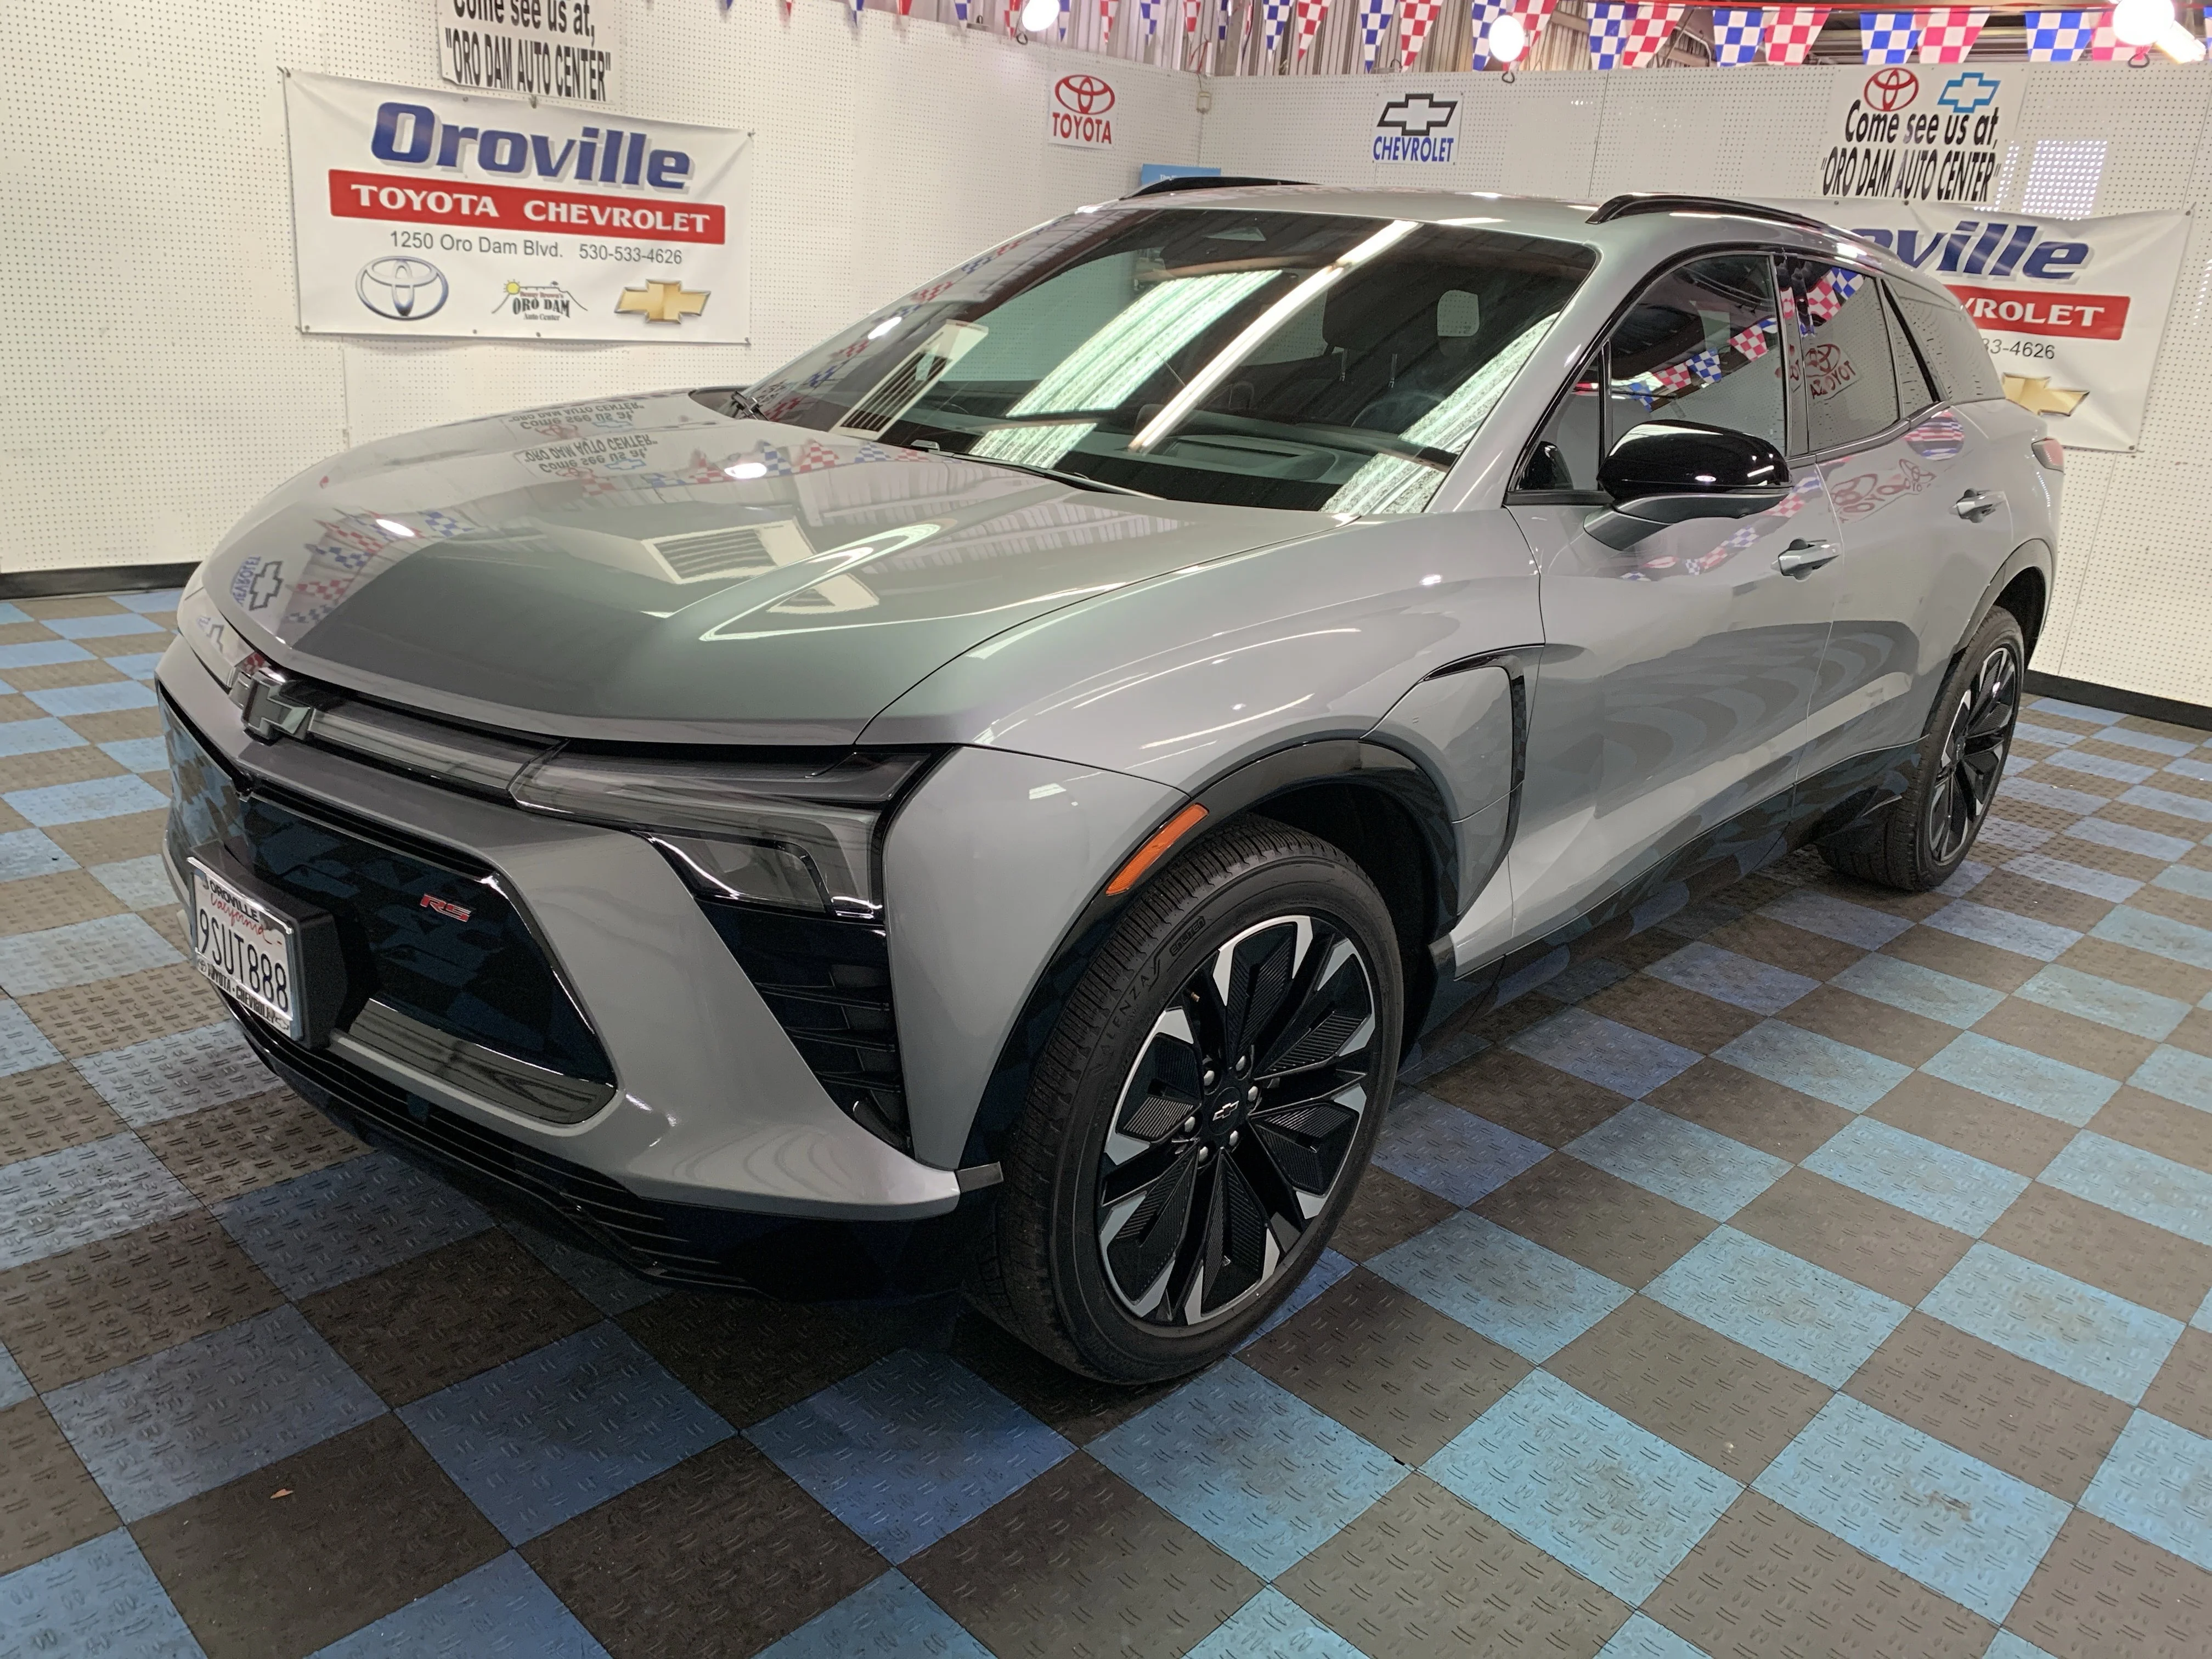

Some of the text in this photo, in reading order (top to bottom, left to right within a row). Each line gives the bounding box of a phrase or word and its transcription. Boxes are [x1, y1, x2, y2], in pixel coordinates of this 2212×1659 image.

[510, 0, 541, 29] see
[549, 0, 567, 33] us
[574, 0, 595, 48] at,
[445, 27, 612, 101] "ORO DAM AUTO CENTER"
[371, 101, 692, 192] Oroville
[1052, 111, 1111, 144] TOYOTA
[1846, 99, 1999, 150] Come see us at,
[1373, 136, 1454, 162] CHEVROLET
[1820, 146, 2001, 202] "ORO DAM AUTO CENTER"
[351, 184, 710, 233] TOYOTA CHEVROLET
[390, 231, 683, 265] 1250 Oro Dam Blvd. 530-533-4626
[512, 297, 570, 318] ORO DAM
[210, 880, 259, 923] OROVILLE
[420, 894, 472, 922] RS
[200, 908, 289, 1013] 9SUT888
